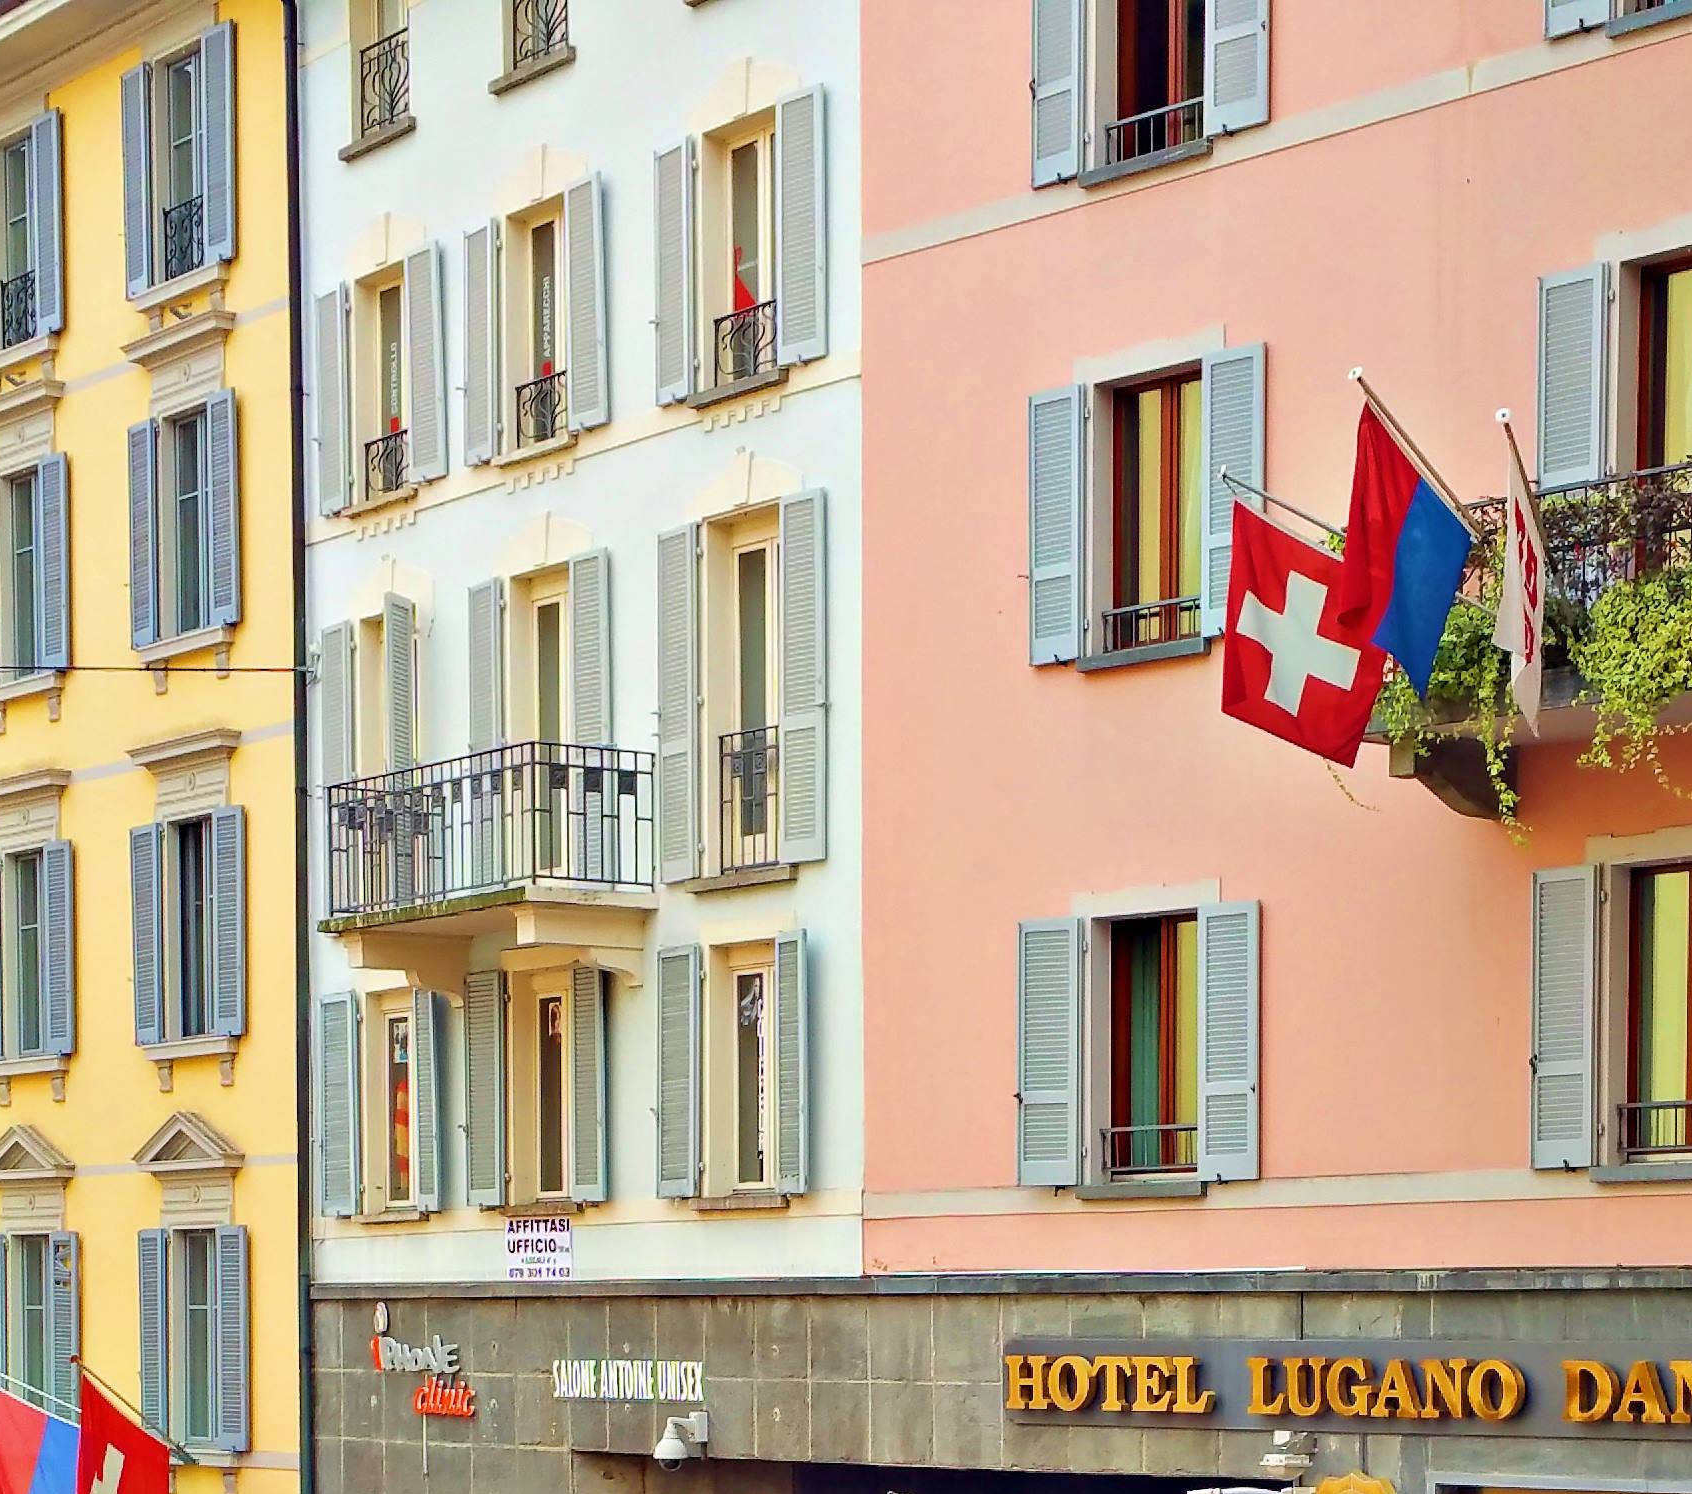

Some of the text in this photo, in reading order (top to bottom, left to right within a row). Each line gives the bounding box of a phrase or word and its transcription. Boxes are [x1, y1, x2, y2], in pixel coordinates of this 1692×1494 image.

[507, 1218, 570, 1234] AFFITTASI
[507, 1238, 557, 1254] UFFICIO
[413, 1376, 476, 1417] clinic
[552, 1358, 597, 1399] SALONE
[656, 1360, 704, 1402] UNISEX
[1005, 1354, 1216, 1415] HOTEL
[1246, 1356, 1526, 1422] LUGANO
